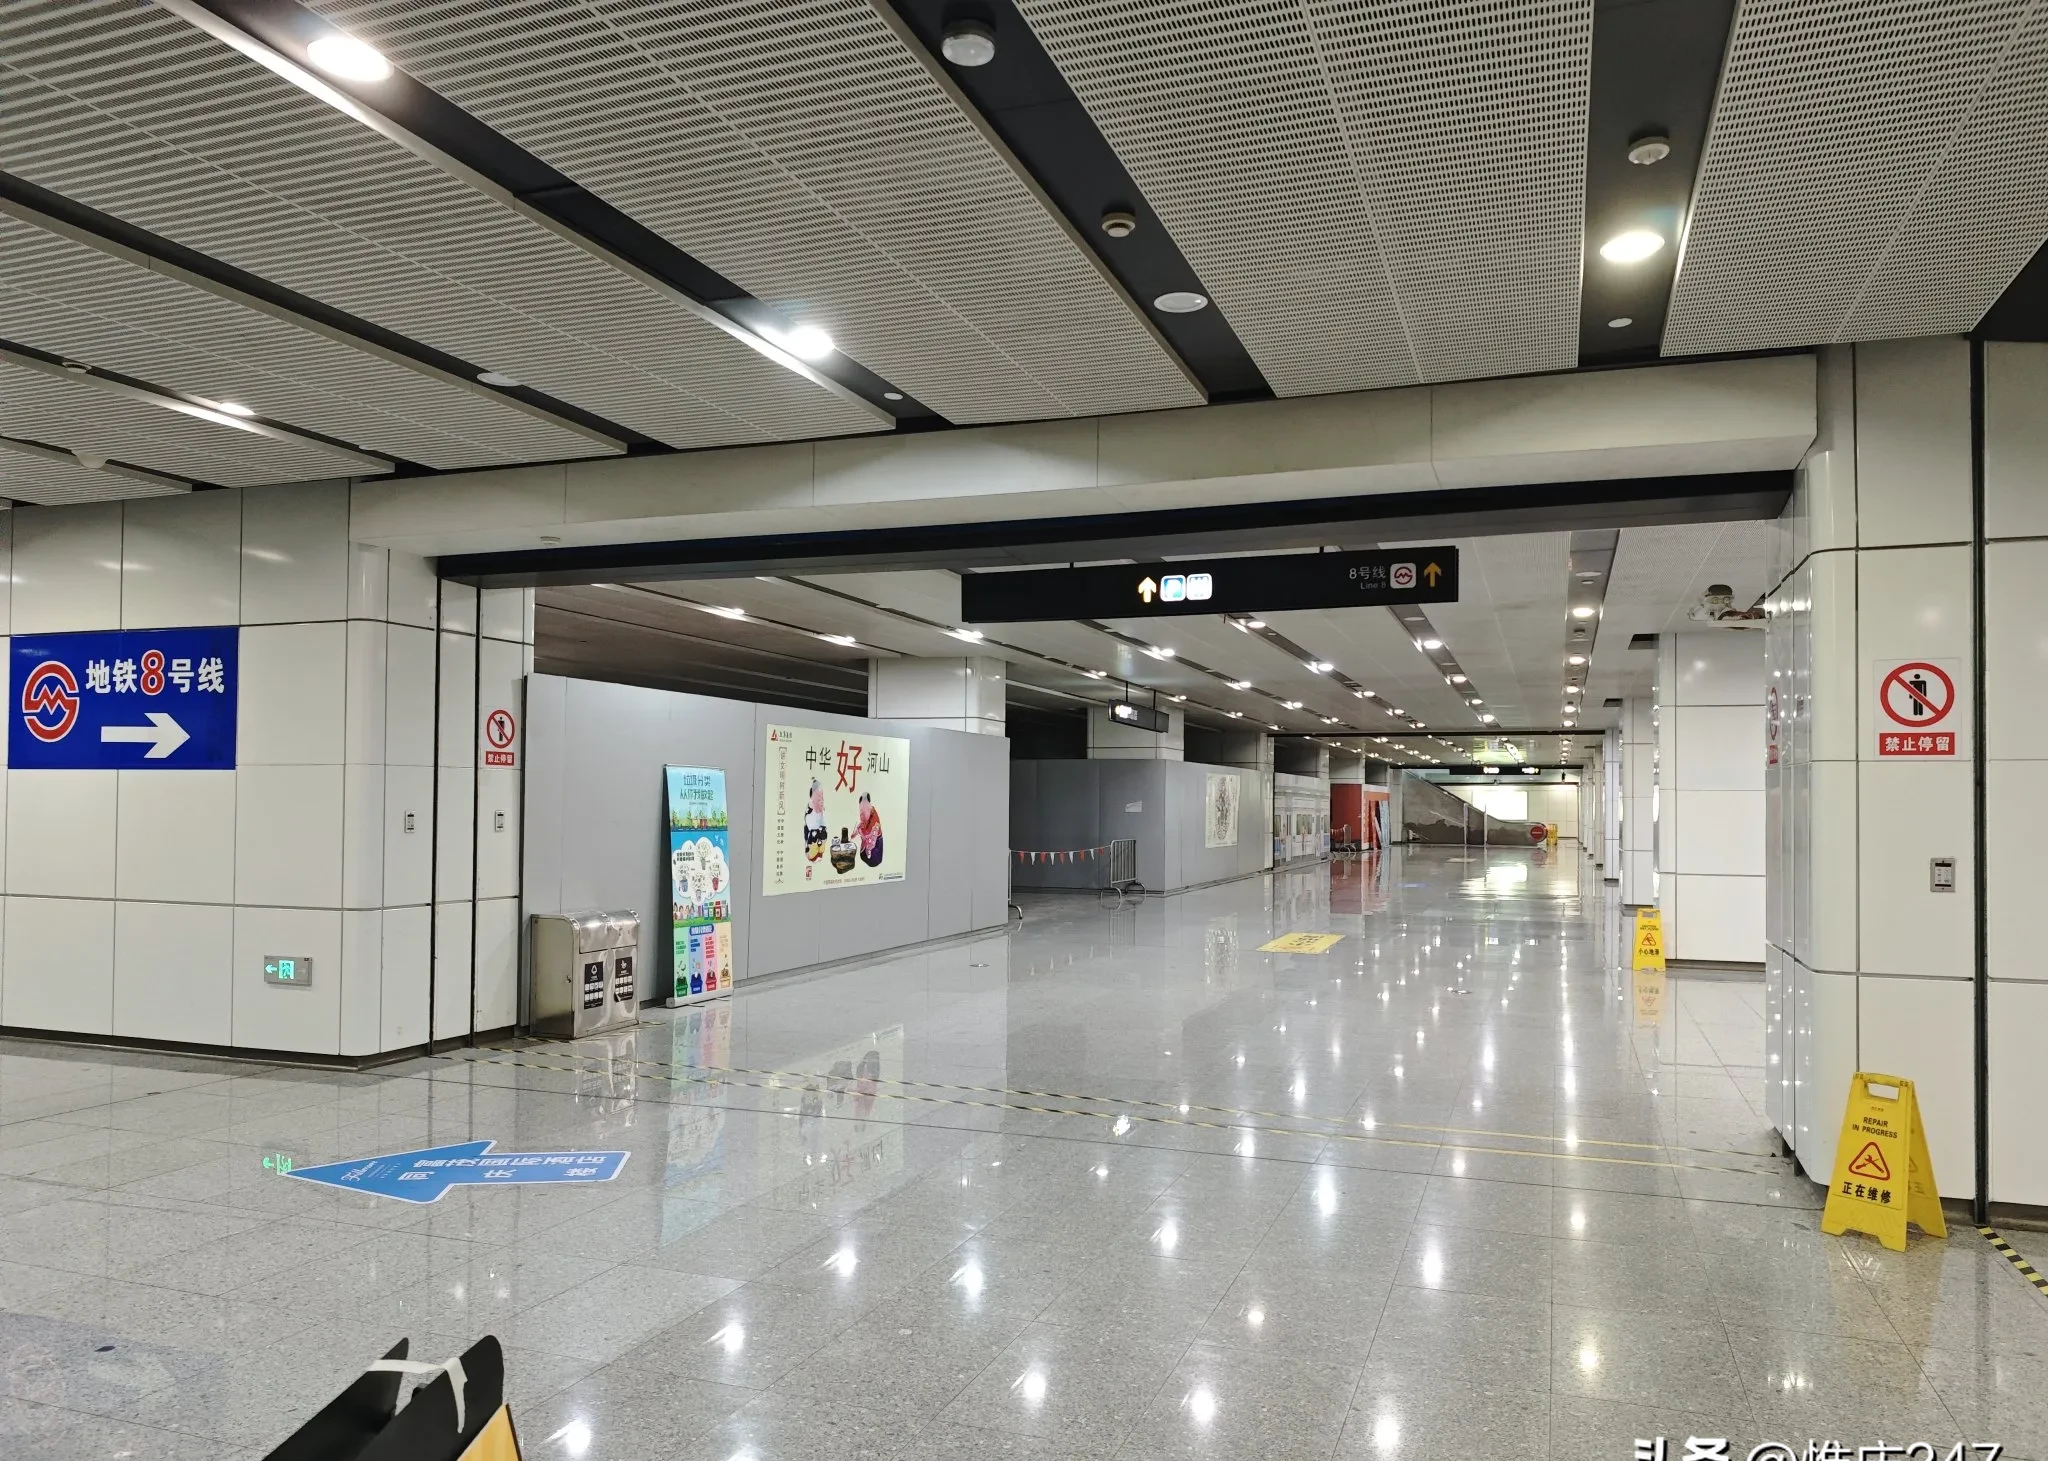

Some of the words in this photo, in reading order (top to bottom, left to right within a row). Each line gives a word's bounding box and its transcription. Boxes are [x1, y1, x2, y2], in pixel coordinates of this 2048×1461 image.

[1349, 565, 1386, 579] 8号线
[1360, 582, 1378, 590] Line
[1380, 581, 1387, 589] 8
[85, 649, 225, 696] 地铁8号线
[1885, 736, 1950, 752] 禁止停留
[487, 753, 513, 764] 禁止停留
[683, 774, 712, 787] 垃圾分类
[1863, 1117, 1888, 1127] REPAIR
[1852, 1123, 1860, 1131] IN
[1862, 1126, 1897, 1138] PROGRESS
[1841, 1181, 1892, 1204] 正在维修
